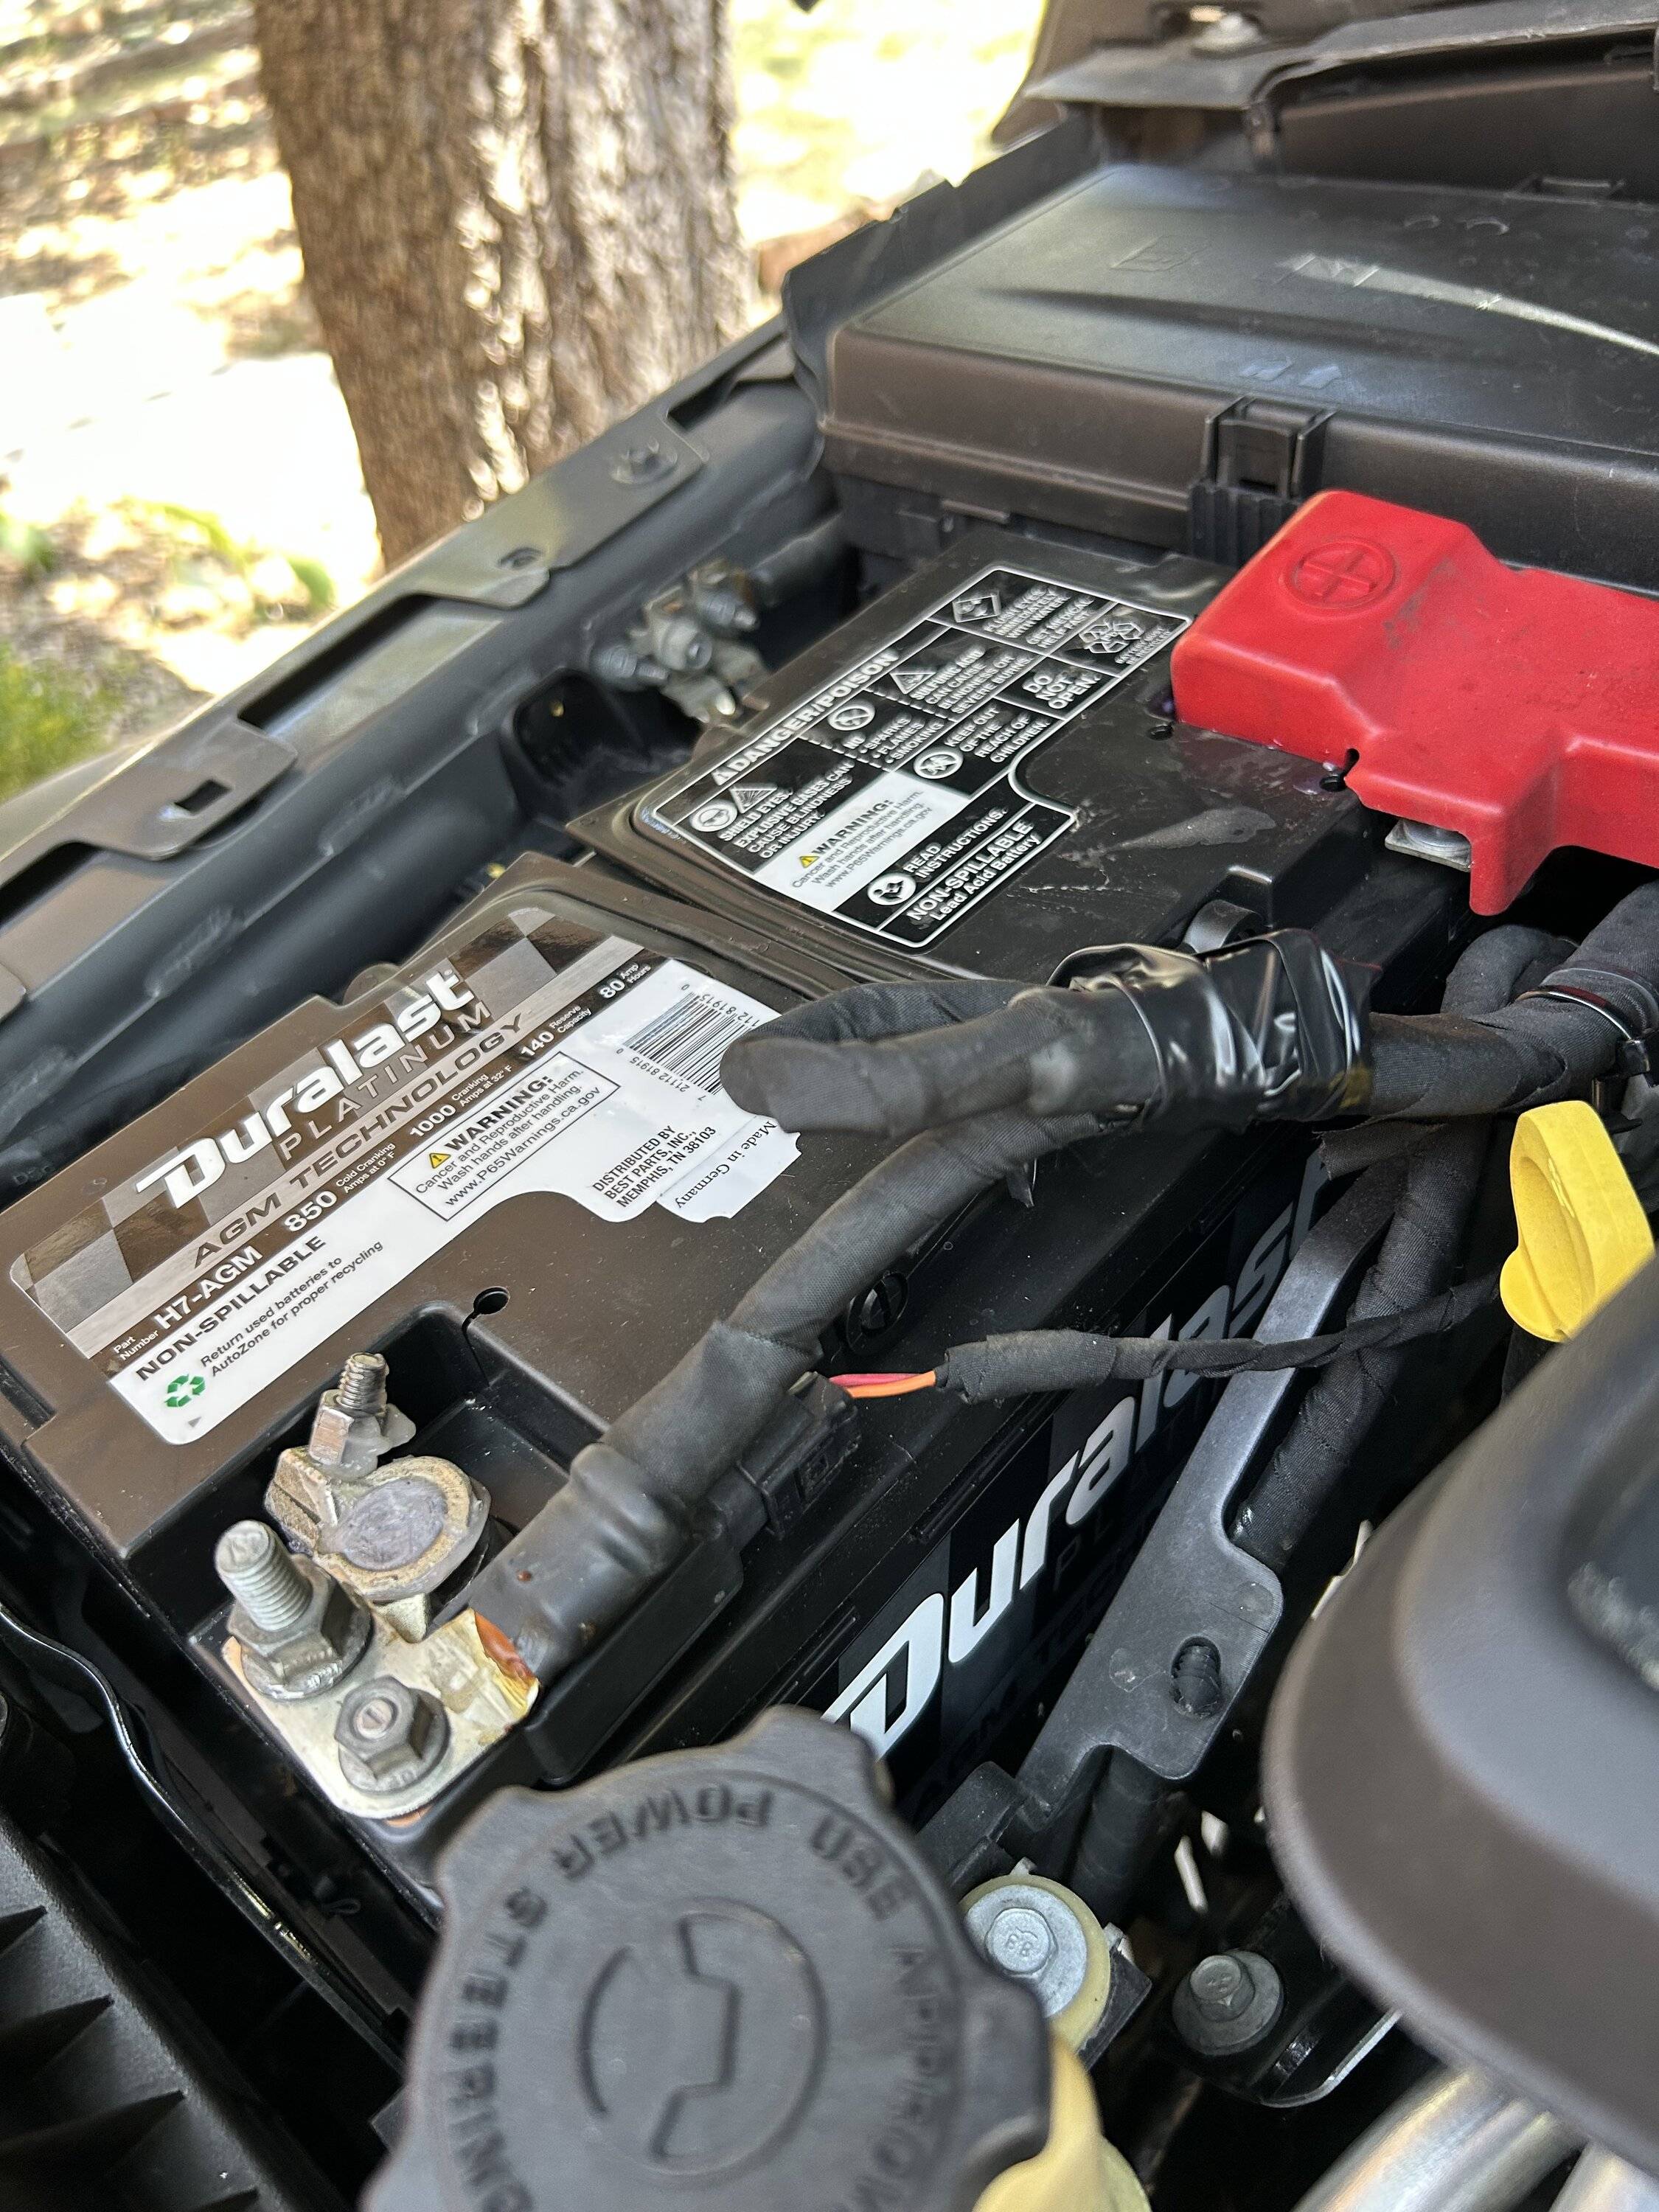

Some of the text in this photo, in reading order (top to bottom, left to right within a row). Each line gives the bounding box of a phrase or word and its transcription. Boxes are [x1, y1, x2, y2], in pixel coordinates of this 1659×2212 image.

[984, 607, 1021, 632] FLUSH
[995, 589, 1060, 636] IMMEDIATELY
[1006, 619, 1035, 638] WITH
[1026, 597, 1094, 644] GET MEDICAL
[1037, 627, 1067, 648] HELP
[910, 647, 984, 700] SULFURIC ACID
[925, 663, 987, 704] CAN CAUSE
[938, 653, 1015, 709] BLINDNESS OR
[951, 681, 996, 713] SEVERE
[1022, 675, 1052, 693] DO
[1035, 674, 1073, 700] NOT
[1048, 674, 1101, 709] OPEN.
[733, 650, 899, 772] DANGER/POISON
[944, 705, 999, 747] KEEP OUT
[959, 721, 1001, 752] OF THE
[974, 712, 1030, 758] REACH OF
[842, 733, 865, 749] NO
[990, 719, 1051, 762] CHILDREN.
[719, 788, 793, 841] SHIELD EYES.
[735, 762, 855, 848] EXPLOSIVE GASES CAN
[749, 778, 852, 853] CAUSE BLINDNESS
[812, 800, 894, 855] WARNING:
[759, 812, 825, 858] OR INJURY.
[792, 791, 924, 888] Cancer and Reproductive Harm.
[812, 804, 923, 885] Wash hands after handling.
[825, 807, 932, 888] www.P65Warnings.ca.gov
[903, 844, 942, 872] READ
[915, 807, 1009, 878] INSTRUCTIONS.
[906, 819, 1034, 921] NON-SPILLABLE
[930, 833, 1042, 920] Lead Acid Battery
[599, 963, 640, 999] 80 Amp
[627, 964, 652, 984] Hours
[520, 1004, 582, 1058] 140 Reserve
[557, 1007, 592, 1034] Capacity
[737, 1011, 761, 1029] 112
[136, 970, 475, 1209] Duralast
[282, 1001, 493, 1161] PLATINUM
[459, 1087, 484, 1107] Amps
[483, 1079, 493, 1089] at
[491, 1071, 504, 1082] 32°
[630, 1057, 659, 1077] 81915
[659, 1071, 689, 1092] 21112
[410, 1074, 489, 1137] 1000 Cranking
[416, 1070, 584, 1194] Cancer and Reproductive Harm.
[445, 1076, 553, 1151] WARNING:
[194, 1013, 524, 1269] AGM TECHNOLOGY
[437, 1086, 583, 1191] Wash hands after handling.
[445, 1087, 600, 1206] www.P65Warnings.ca.gov
[592, 1125, 676, 1192] DISTRIBUTED BY
[605, 1131, 697, 1200] BEST PARTS, INC.,
[675, 1121, 777, 1208] Made in Germany
[285, 1142, 396, 1232] 850 Cold Cranking
[344, 1172, 370, 1194] Amps
[369, 1165, 380, 1177] at
[378, 1157, 389, 1168] 0°
[616, 1126, 717, 1208] MEMPHIS, TN 38103
[135, 1236, 327, 1381] NON-SPILLABLE
[153, 1245, 263, 1329] H7-AGM
[201, 1256, 343, 1368] Return used batteries to
[211, 1241, 383, 1377] AutoZone for proper recycling
[113, 1336, 136, 1354] Part
[119, 1329, 159, 1362] Number
[551, 1783, 773, 1881] POWER
[810, 1815, 905, 1921] USE
